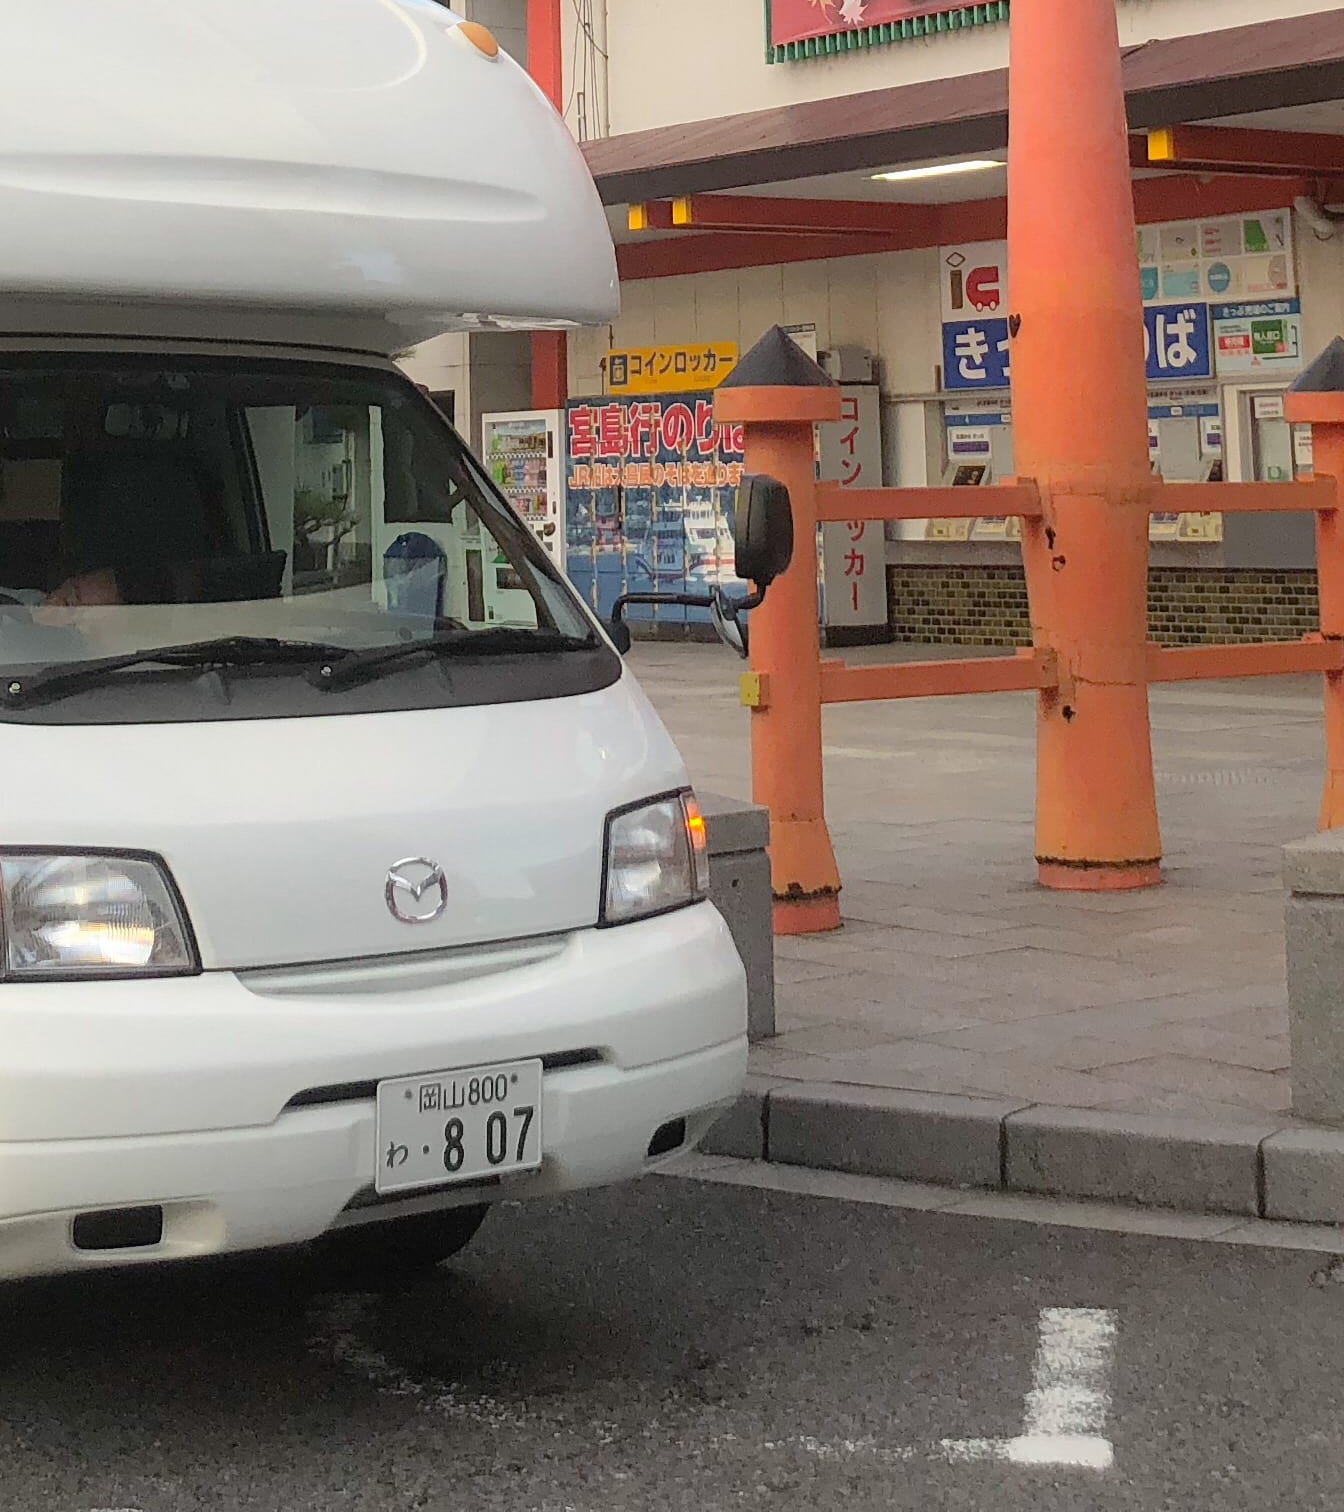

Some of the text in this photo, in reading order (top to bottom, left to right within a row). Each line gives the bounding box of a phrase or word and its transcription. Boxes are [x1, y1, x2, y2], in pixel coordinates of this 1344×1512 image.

[630, 348, 734, 377] コインロッカー
[955, 308, 1198, 380] き ば
[840, 396, 865, 612] コインッカー
[386, 1139, 410, 1169] わ
